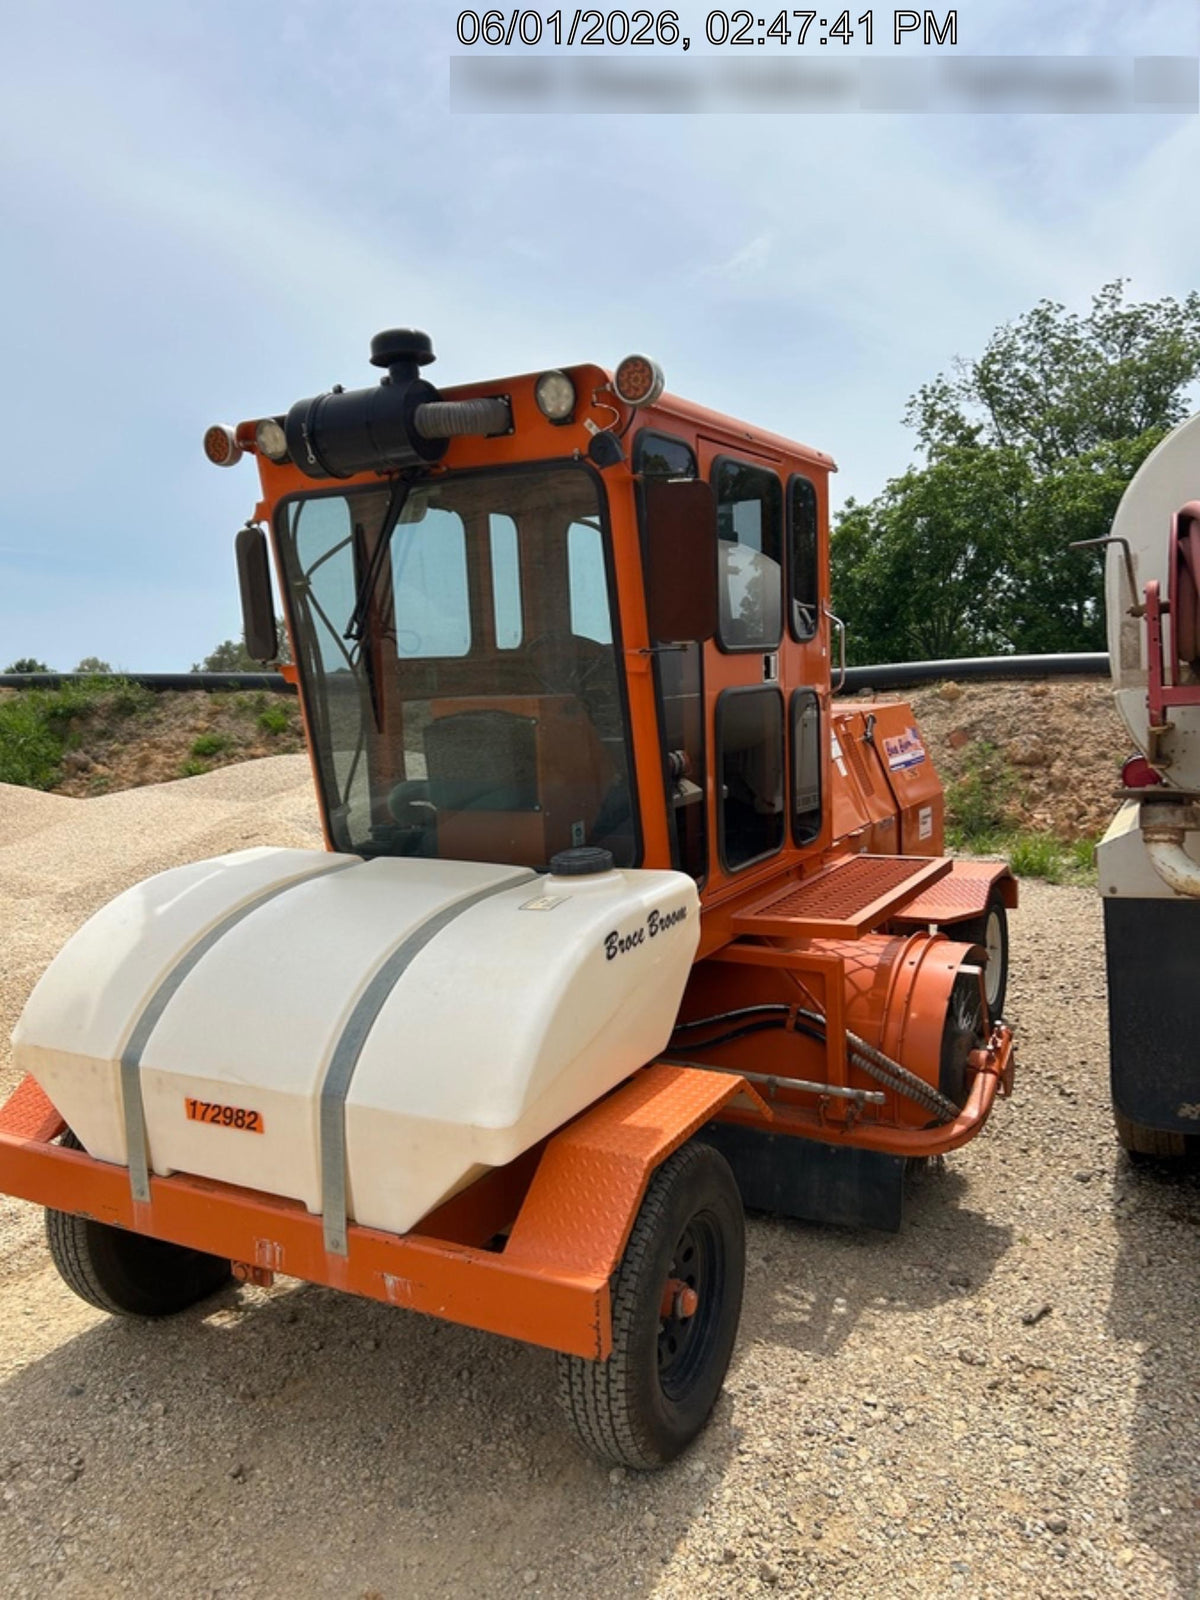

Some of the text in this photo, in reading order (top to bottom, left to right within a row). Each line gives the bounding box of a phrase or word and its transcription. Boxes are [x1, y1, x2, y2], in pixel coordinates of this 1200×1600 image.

[604, 906, 687, 960] Broce Broom
[189, 1099, 259, 1132] 172982
